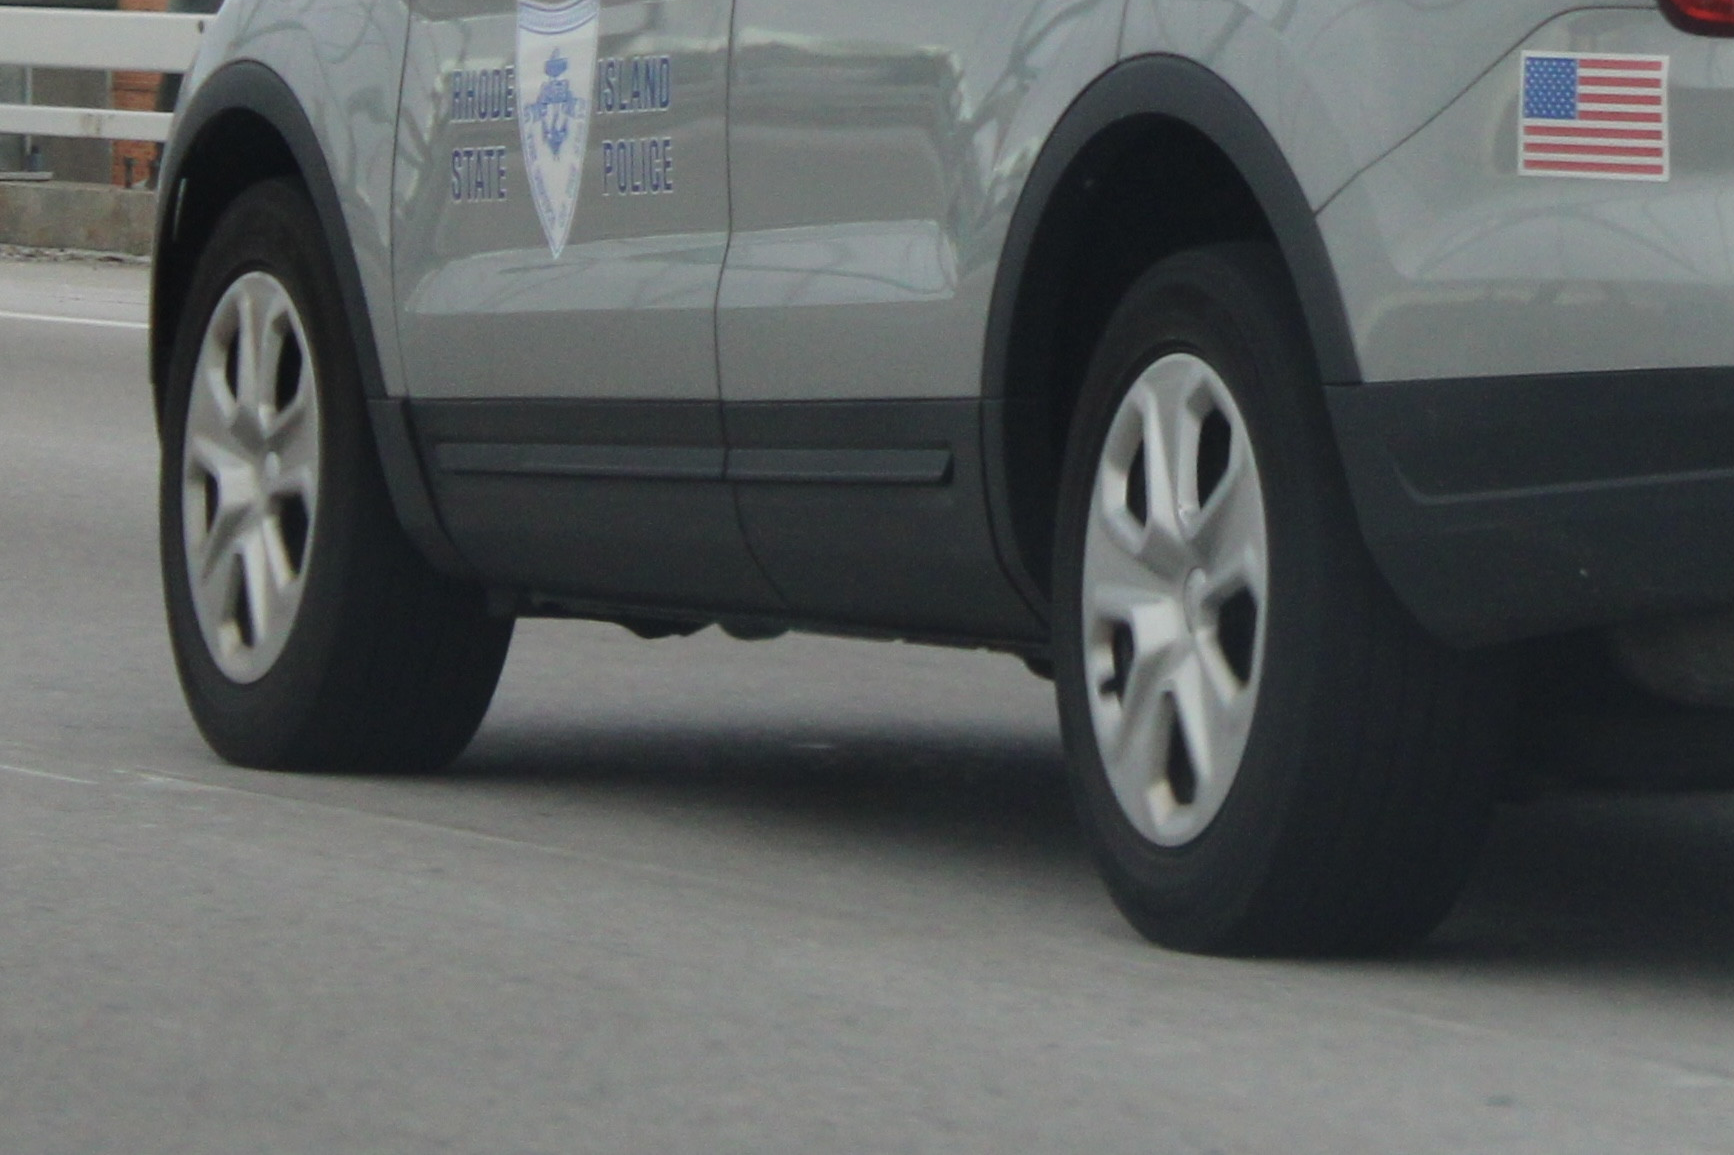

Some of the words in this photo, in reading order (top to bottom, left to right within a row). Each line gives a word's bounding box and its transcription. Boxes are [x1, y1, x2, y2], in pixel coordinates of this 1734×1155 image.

[450, 63, 515, 123] RHODE
[596, 54, 670, 115] ISLAND
[452, 146, 507, 203] STATE
[601, 137, 673, 196] POLICE
